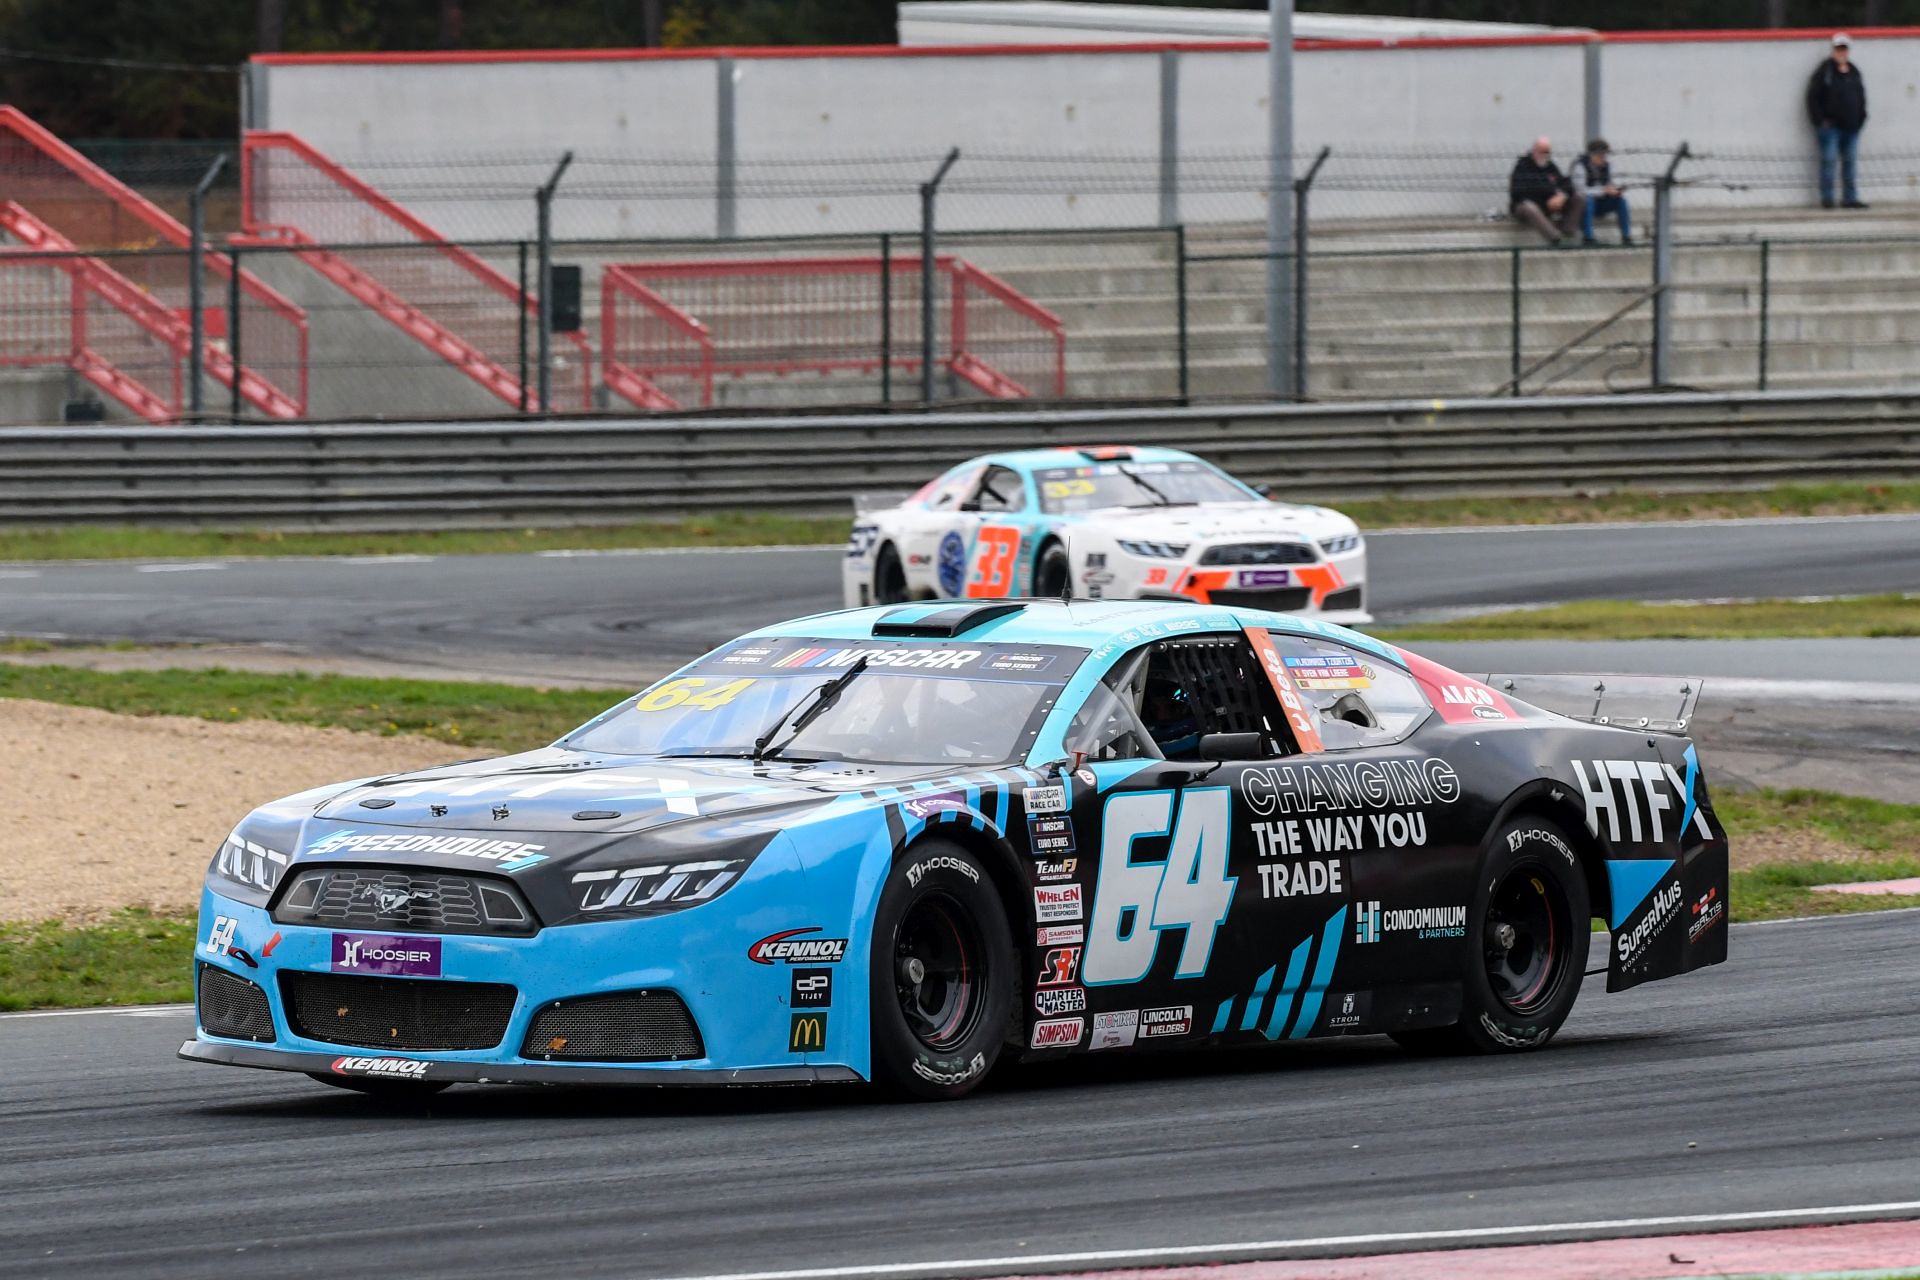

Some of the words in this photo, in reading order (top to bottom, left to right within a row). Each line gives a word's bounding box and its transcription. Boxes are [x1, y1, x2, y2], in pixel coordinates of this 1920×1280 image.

[966, 526, 1021, 599] 33
[815, 649, 981, 669] NASCAR
[636, 679, 759, 712] 64
[1441, 685, 1494, 705] ALCO
[1241, 758, 1460, 815] CHANGING
[1030, 801, 1046, 809] RACE
[1047, 800, 1061, 808] CAR
[1042, 821, 1065, 832] NASCAR
[1251, 820, 1302, 856] THE
[1306, 815, 1363, 852] WAY
[1369, 812, 1427, 847] YOU
[307, 833, 547, 864] SPEEDHOUSE
[1037, 839, 1051, 849] EURO
[1052, 837, 1069, 848] SERIES
[1522, 829, 1574, 867] HOOSIER
[921, 856, 979, 884] HOOSIER
[1257, 859, 1342, 899] TRADE
[1036, 887, 1080, 904] WHELEN
[1081, 786, 1239, 987] 64
[1384, 906, 1466, 931] CONDOMINIUM
[205, 915, 238, 956] 64
[1425, 928, 1465, 938] PARTNERS
[362, 948, 431, 963] HOOSIER
[757, 941, 843, 958] KENNOL
[1036, 988, 1083, 1008] QUARTER
[1045, 999, 1084, 1015] MASTER
[1143, 1009, 1183, 1024] LINCOLN
[1035, 1022, 1080, 1044] SIMPSON
[1150, 1023, 1186, 1035] WELDERS
[337, 1057, 430, 1074] KENNOL
